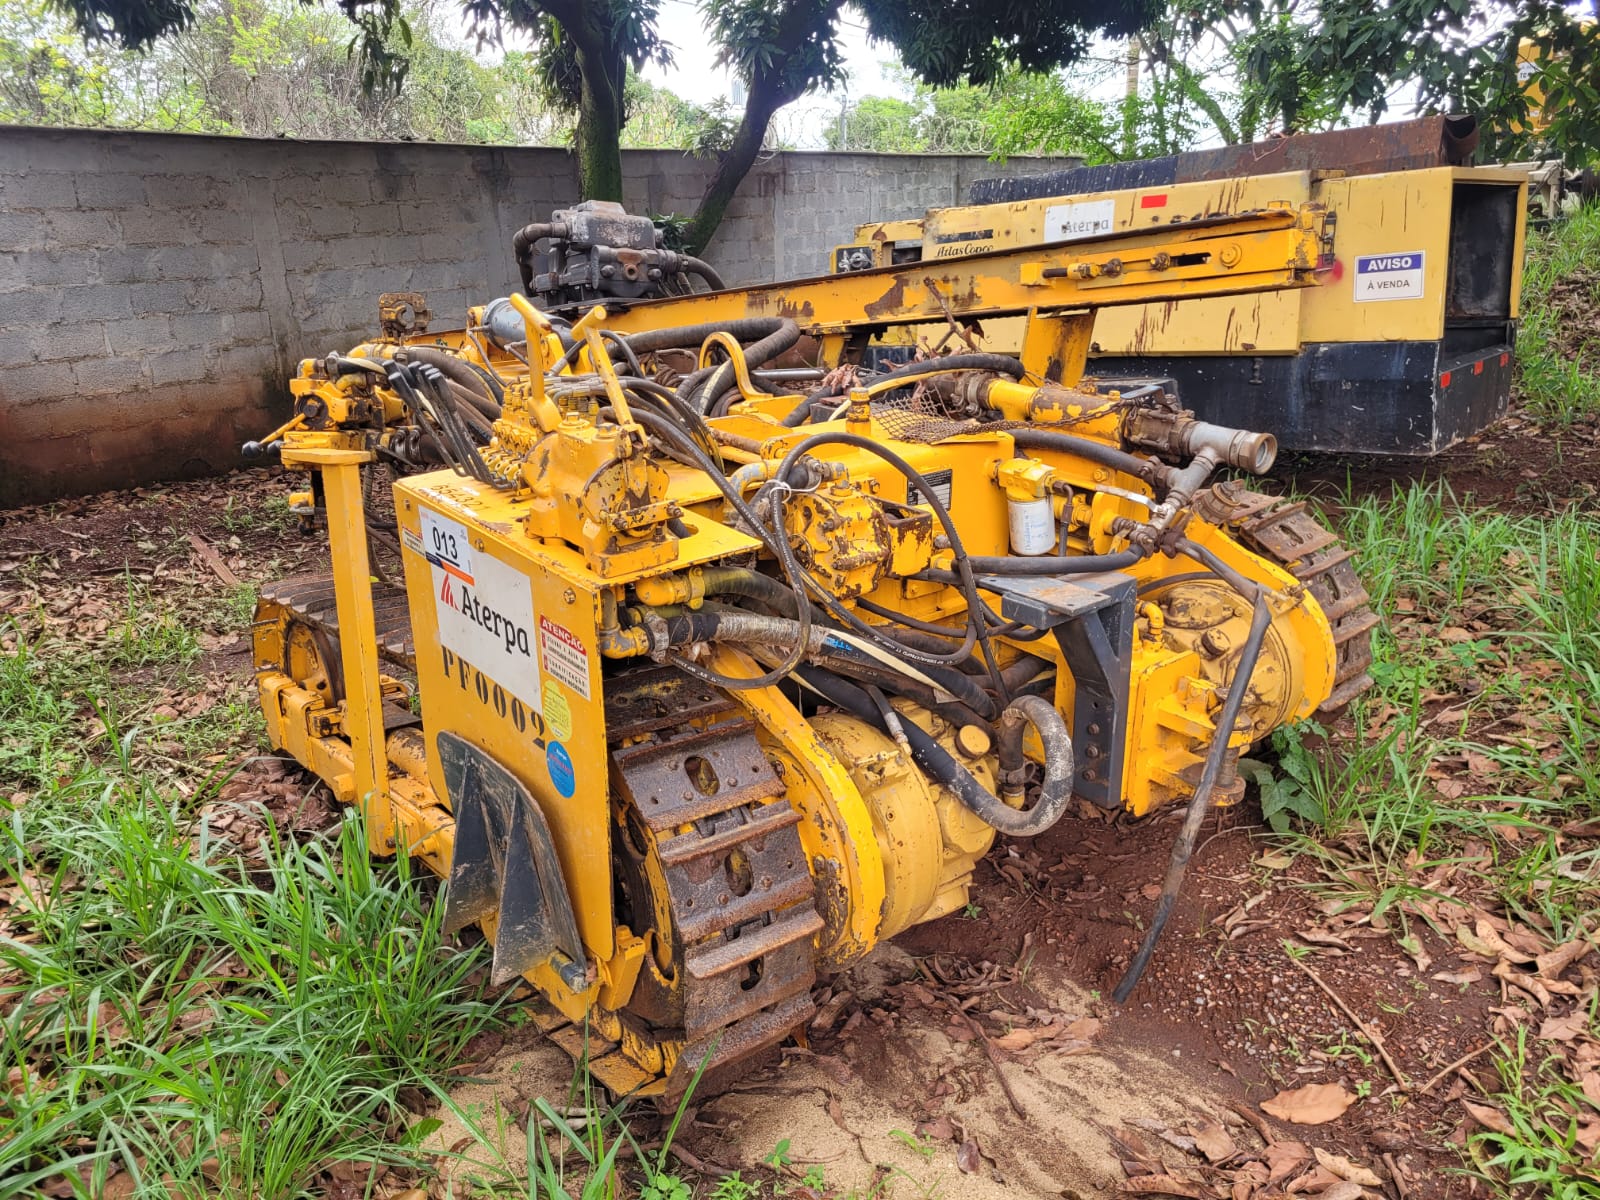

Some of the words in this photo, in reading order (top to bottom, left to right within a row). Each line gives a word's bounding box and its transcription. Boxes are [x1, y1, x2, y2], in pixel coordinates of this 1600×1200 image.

[937, 246, 963, 257] Atlas
[1367, 257, 1412, 271] AVISO
[1377, 280, 1410, 288] VENDA
[433, 526, 458, 560] 013
[462, 585, 531, 657] Aterpa
[441, 645, 545, 751] PF0002
